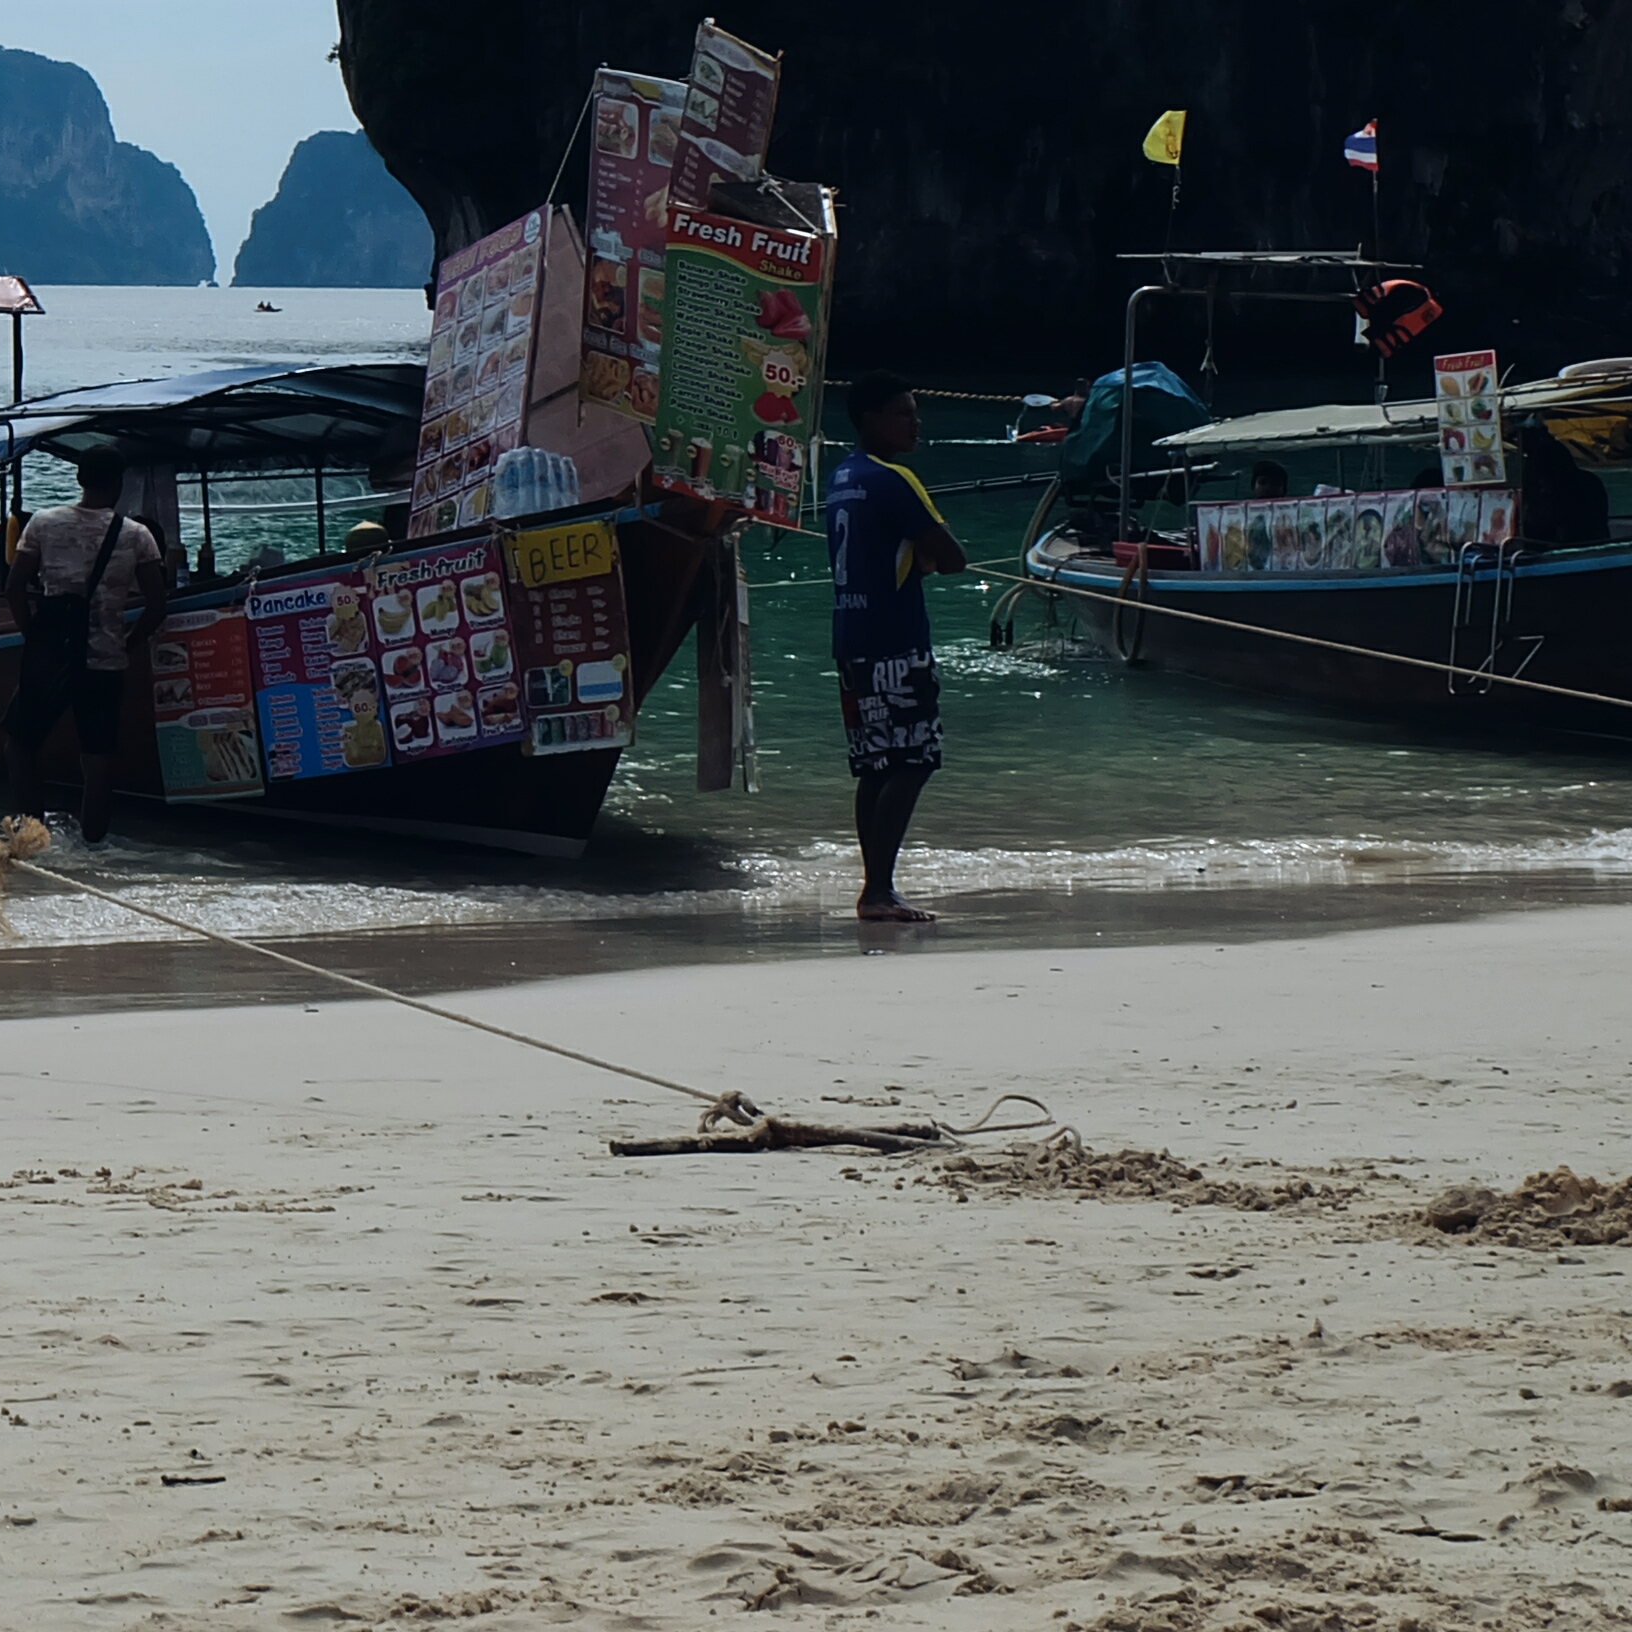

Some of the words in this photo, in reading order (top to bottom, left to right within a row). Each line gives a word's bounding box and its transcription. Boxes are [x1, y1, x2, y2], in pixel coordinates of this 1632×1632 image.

[672, 213, 743, 248] Fresh
[751, 231, 811, 264] Fruit
[678, 261, 715, 277] Banana
[719, 269, 747, 285] Shake
[759, 259, 803, 281] Shake
[678, 273, 710, 289] Mango
[714, 282, 742, 297] Shake
[677, 286, 729, 307] Strawberry
[733, 300, 761, 315] Shake
[677, 298, 710, 315] Dragon
[714, 307, 743, 322] Shake
[675, 324, 703, 340] Apple
[705, 331, 734, 346] Shake
[676, 312, 731, 332] Watermelon
[736, 326, 764, 341] Shake
[674, 337, 707, 353] Orange
[710, 345, 740, 360] Shake
[673, 349, 719, 368] Pineapple
[723, 362, 751, 377] Shake
[765, 364, 806, 386] 50.-
[671, 374, 710, 390] Coconut
[712, 384, 742, 400] Shake
[707, 370, 736, 385] Shake
[670, 386, 702, 402] Carrot
[704, 394, 732, 410] Shake
[670, 398, 703, 416] Papaya
[706, 408, 734, 423] Shake
[529, 533, 603, 583] BEER
[835, 508, 850, 586] 2
[377, 563, 431, 588] Fresh
[436, 549, 485, 577] fruit
[250, 591, 326, 616] Pancake
[872, 658, 910, 694] RIP
[354, 702, 375, 713] 60.-
